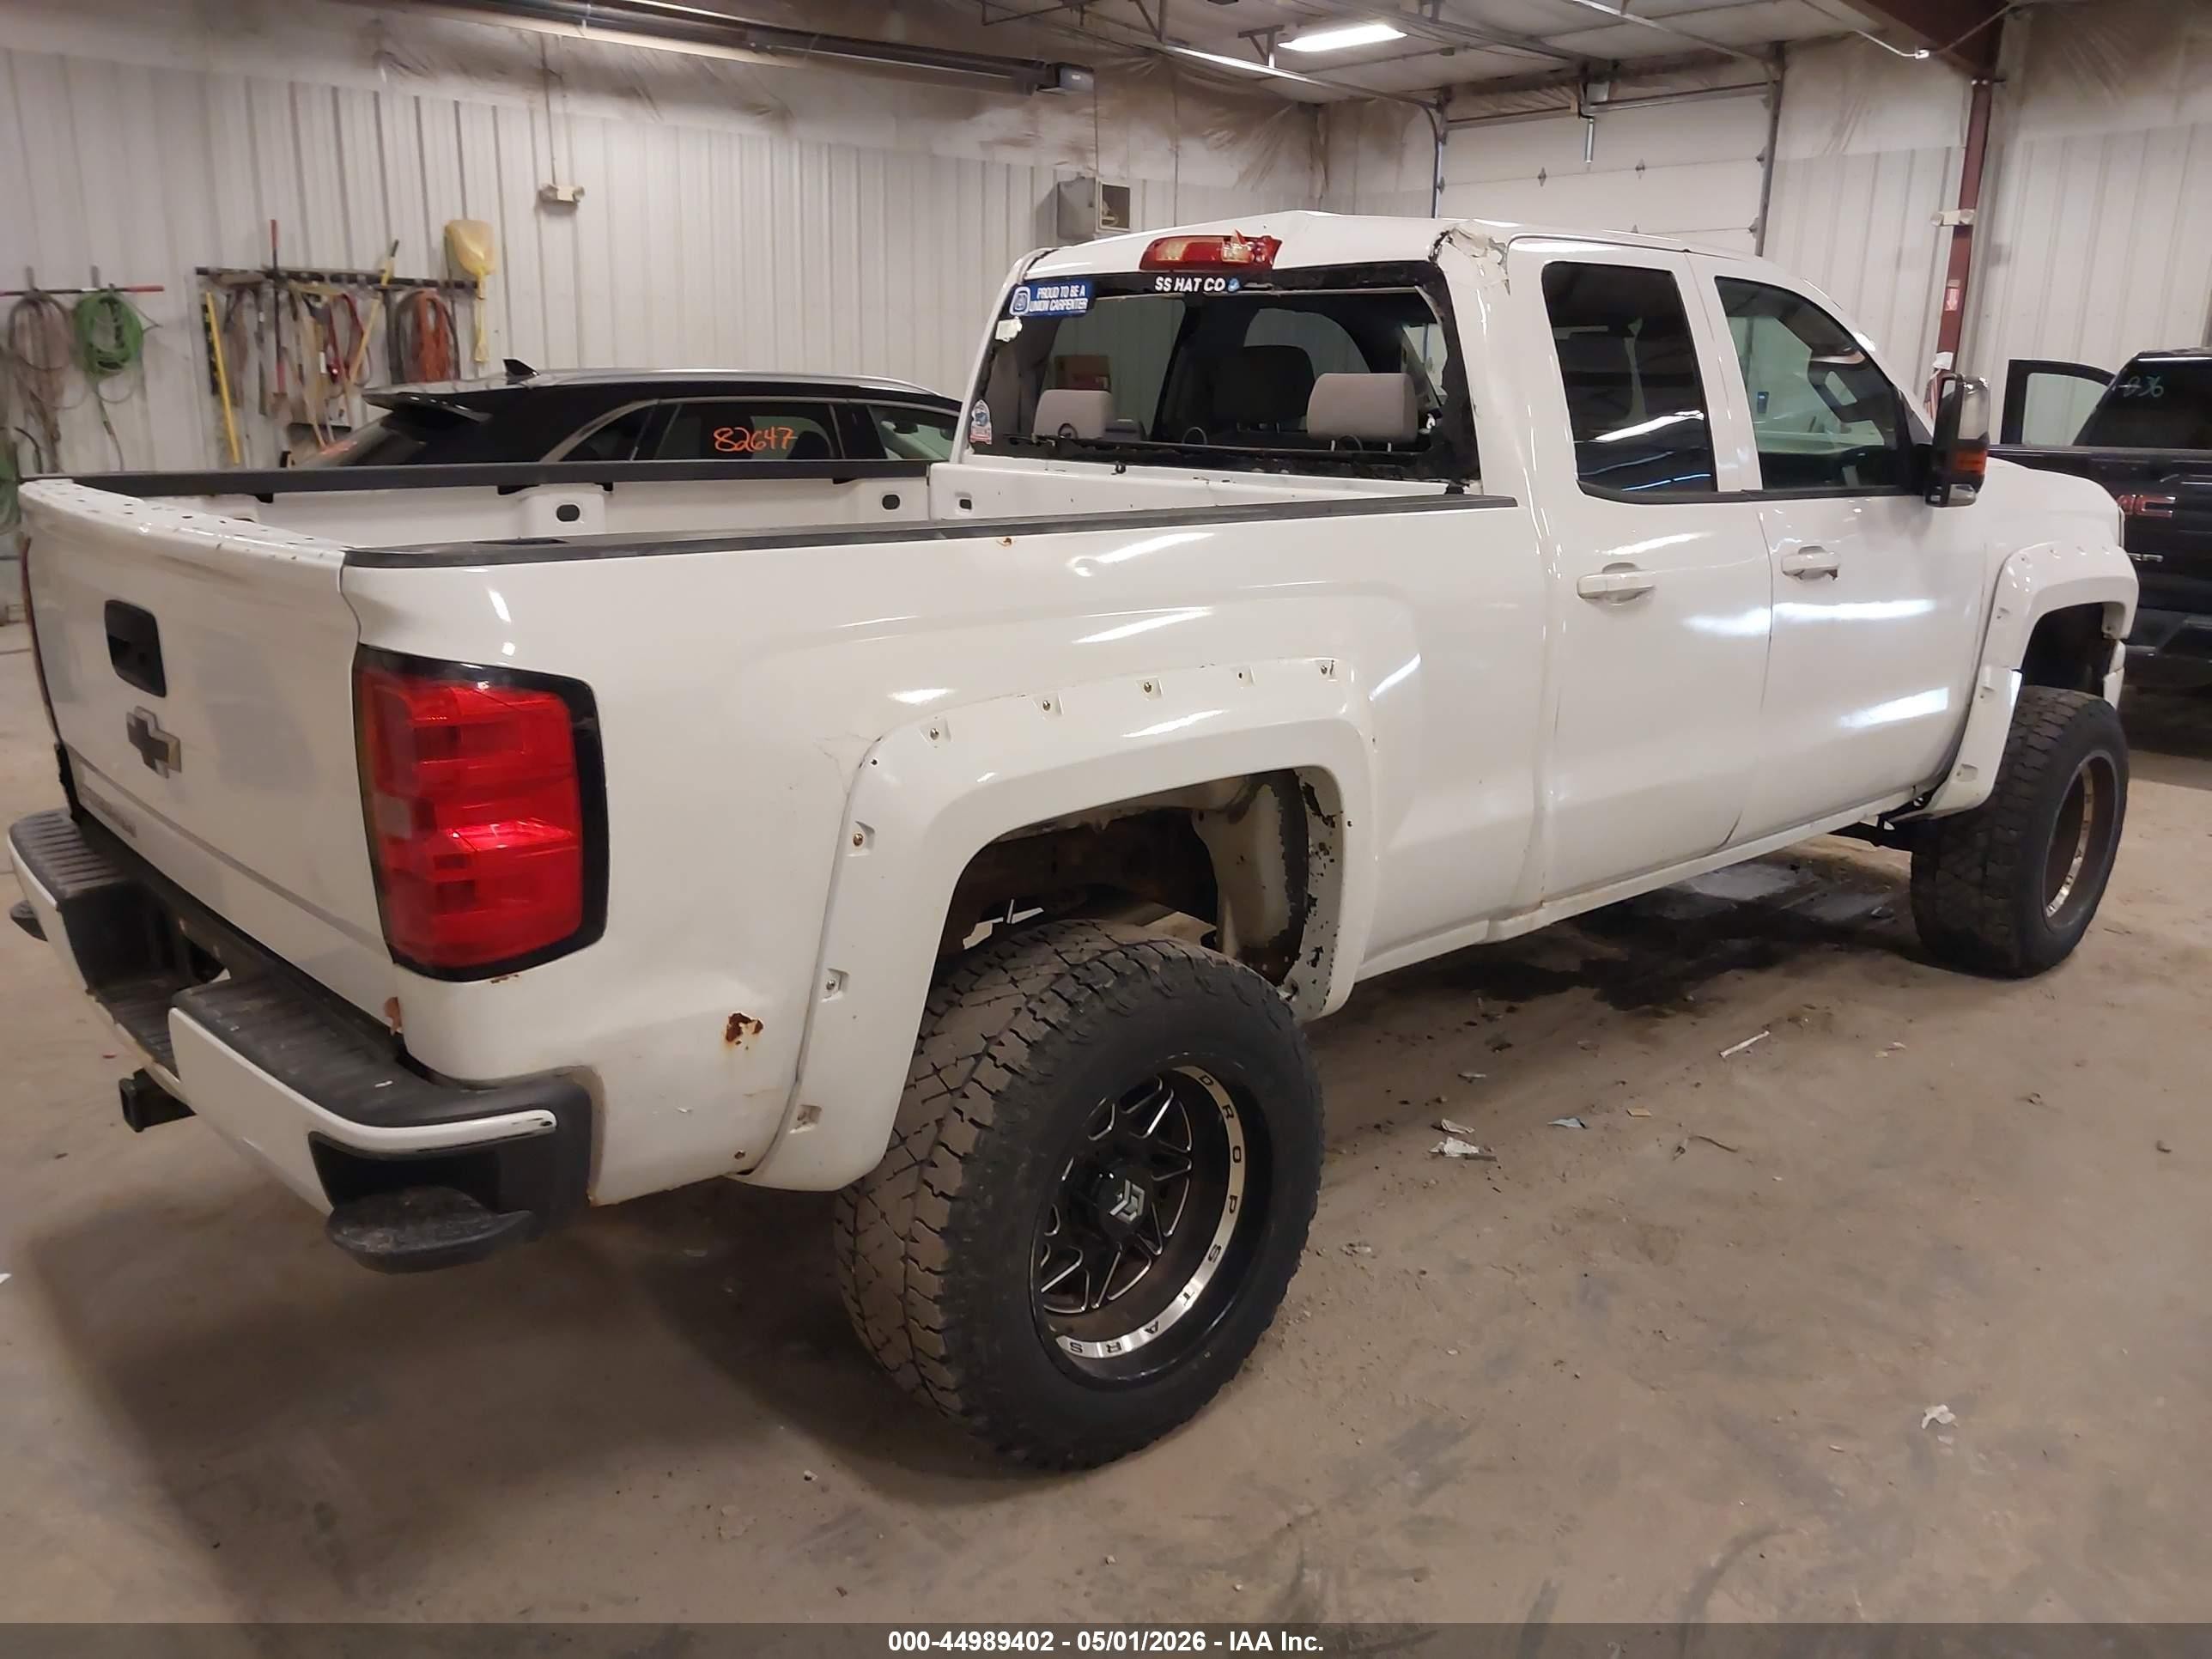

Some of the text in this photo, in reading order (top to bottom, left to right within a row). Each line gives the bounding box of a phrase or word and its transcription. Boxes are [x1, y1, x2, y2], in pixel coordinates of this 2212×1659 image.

[1060, 285, 1070, 297] TO
[1070, 284, 1079, 297] BE
[1079, 284, 1086, 296] A
[1155, 276, 1226, 292] SS HAT CO
[714, 426, 799, 453] 82647
